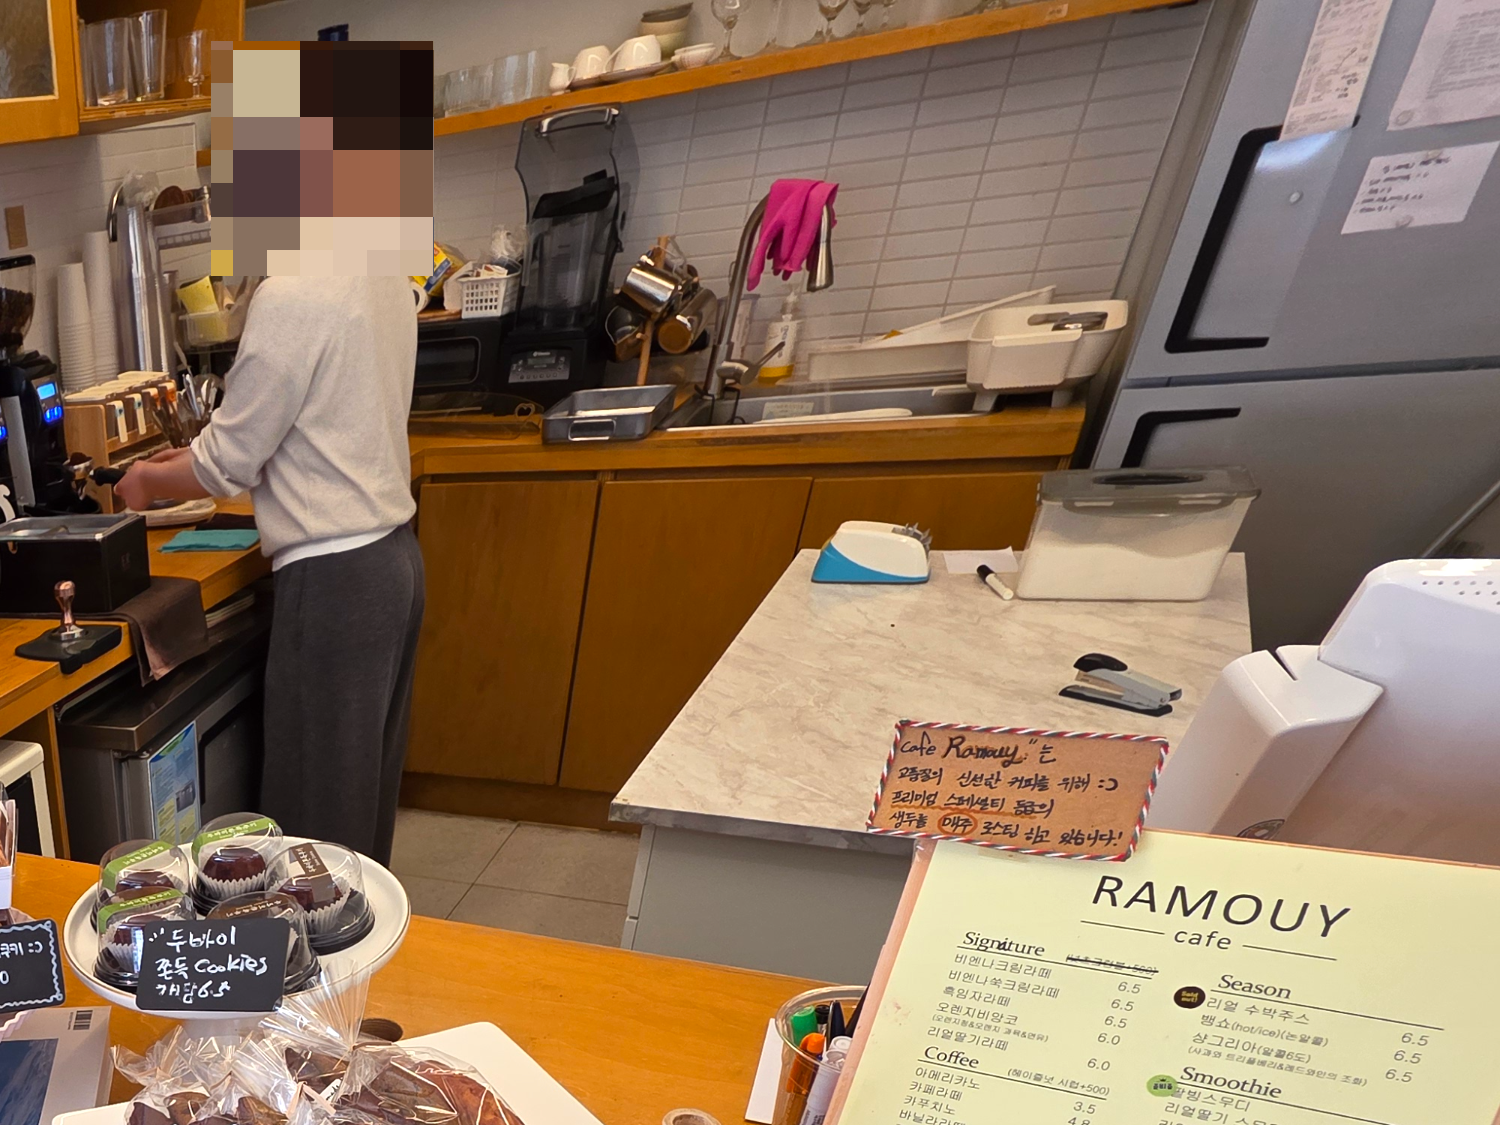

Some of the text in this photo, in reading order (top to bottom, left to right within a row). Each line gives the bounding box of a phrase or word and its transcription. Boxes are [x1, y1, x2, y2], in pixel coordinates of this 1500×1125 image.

[898, 766, 1090, 791] 고품질의 신선한 커피를 위해
[892, 791, 1054, 817] 프리미엄 스페셜티 등급의
[889, 810, 1123, 847] 생두를 매주 로스팅 하고 있습니다!
[1092, 875, 1351, 938] RAMOUY
[166, 926, 236, 953] 두바이
[1174, 930, 1232, 950] cafe
[955, 953, 1052, 979] 비엔나크림라떼
[1118, 981, 1141, 994] 6.5
[1218, 974, 1292, 1000] Season
[948, 970, 1134, 1011] 비엔나쑥크림라떼 6.5
[943, 985, 1127, 1029] 흑임자라떼 6.5
[936, 1001, 1121, 1045] 오렌지비앙코 6.0
[1206, 997, 1430, 1046] 리얼 수박주스 6.5
[924, 1046, 979, 1069] Coffee
[928, 1026, 1110, 1071] 리얼딸기라떼 6.0
[1393, 1050, 1422, 1065] 6.5
[1180, 1066, 1282, 1099] Smoothie
[1384, 1068, 1413, 1084] 6.5
[909, 1080, 963, 1101] 카페라떼
[915, 1067, 1096, 1114] 아메리카노 3.5
[904, 1095, 956, 1115] 카푸치노
[1165, 1102, 1229, 1124] 리얼딸기
